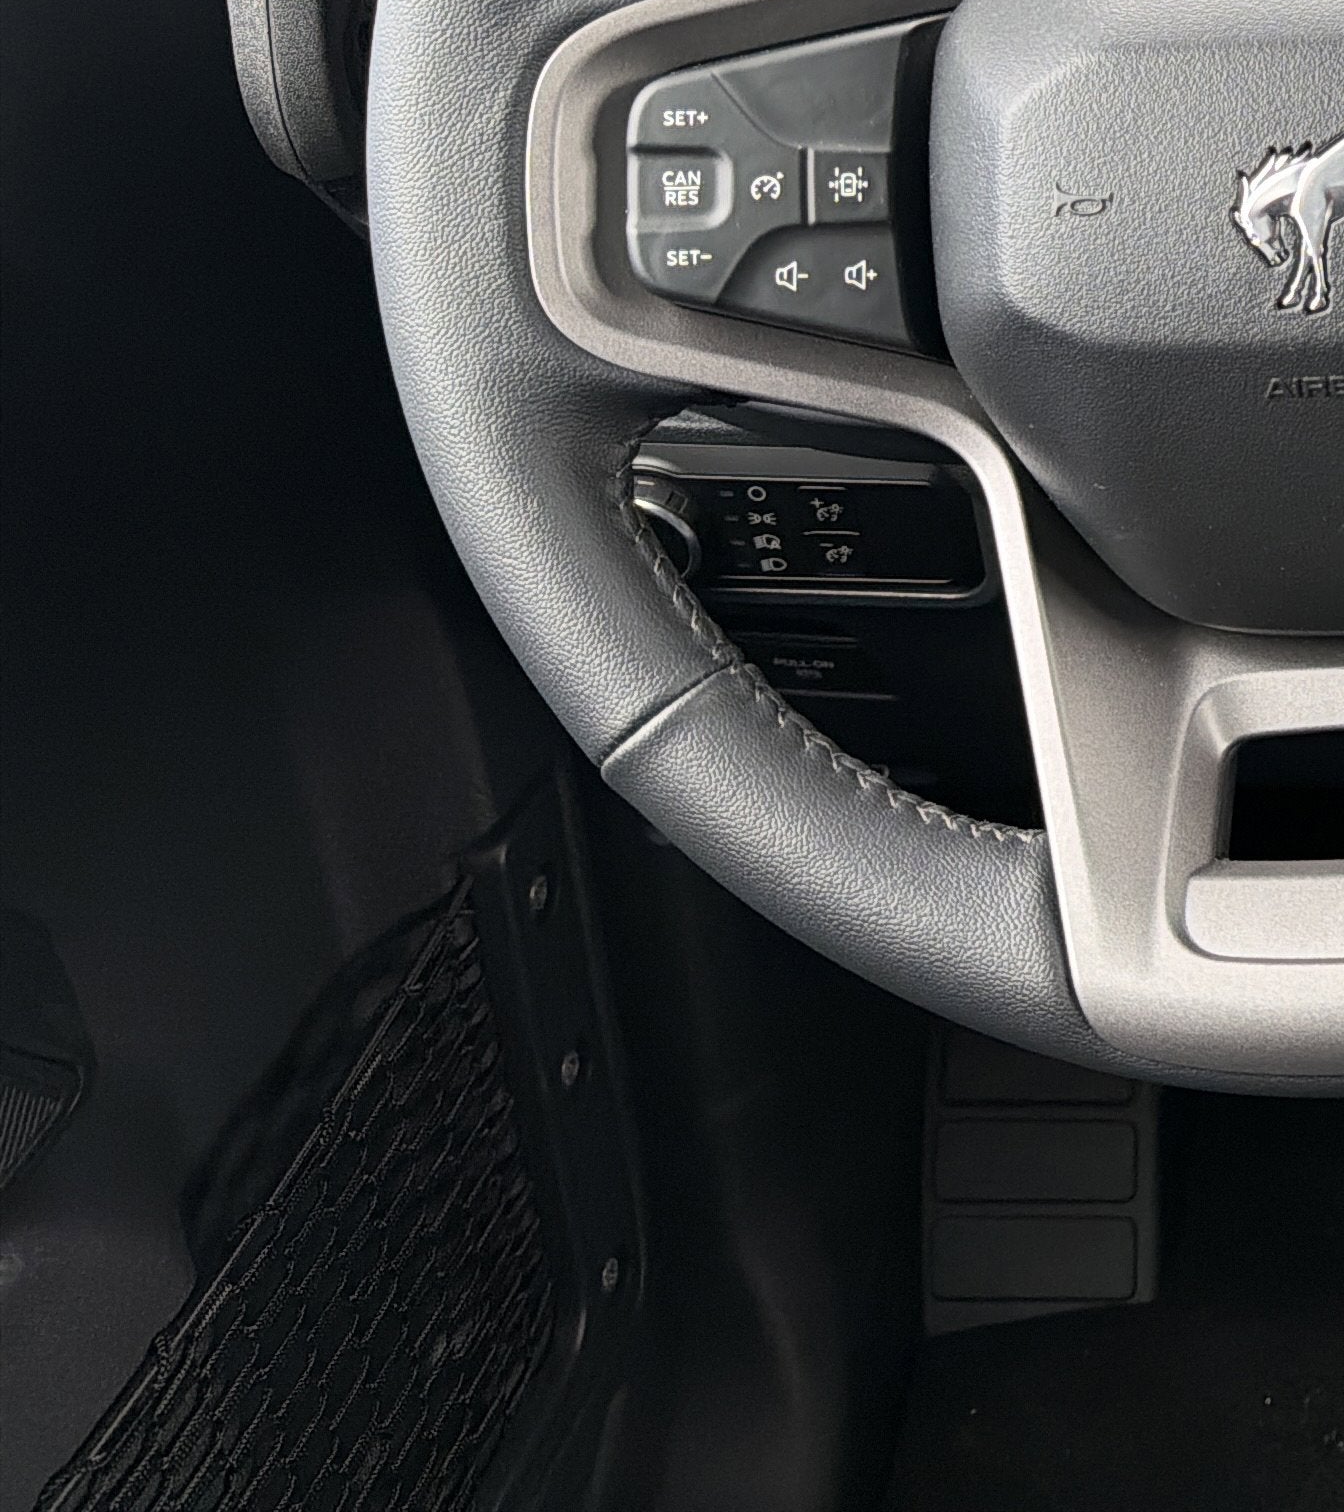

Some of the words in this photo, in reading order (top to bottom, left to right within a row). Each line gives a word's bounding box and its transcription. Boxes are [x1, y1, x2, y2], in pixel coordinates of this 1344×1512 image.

[663, 110, 708, 127] SET+
[662, 170, 701, 186] CAN
[665, 190, 699, 206] RES
